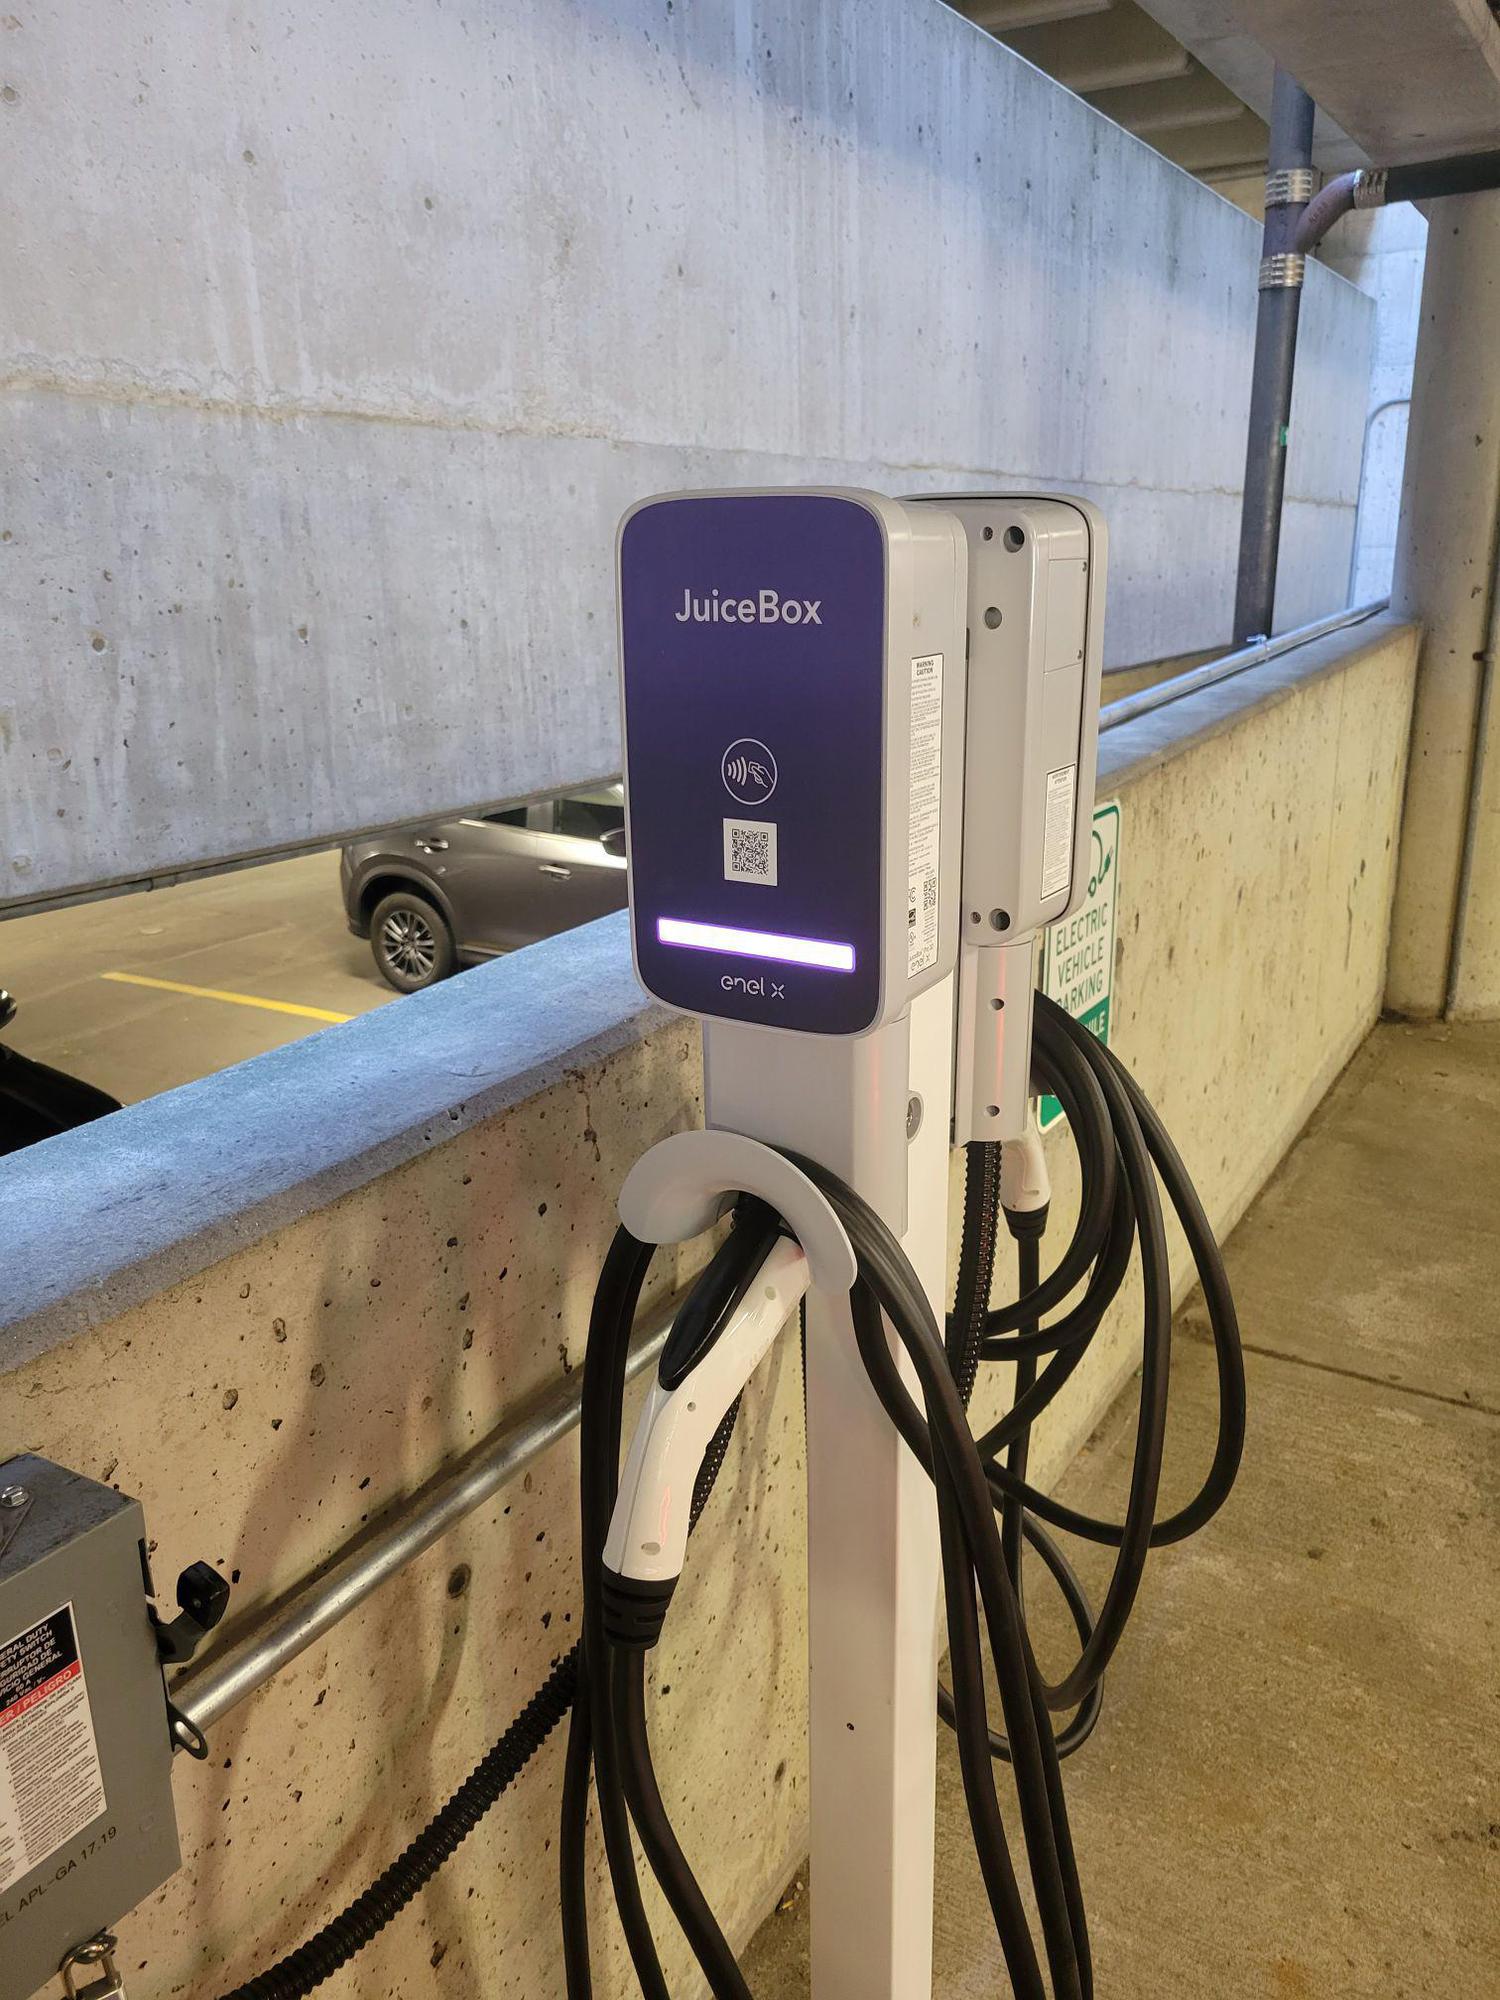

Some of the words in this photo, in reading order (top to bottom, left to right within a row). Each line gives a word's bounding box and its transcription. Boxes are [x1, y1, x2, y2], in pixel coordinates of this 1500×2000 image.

[675, 588, 823, 625] JuiceBox
[1056, 902, 1107, 956] ELECTRIC
[1058, 936, 1104, 988] VEHICLE
[720, 975, 765, 997] enel
[0, 1641, 24, 1660] ERAL
[26, 1623, 48, 1643] DUTY
[0, 1651, 18, 1668] ETY
[20, 1629, 53, 1656] SWITCH
[0, 1646, 42, 1679] RRUPTOR
[44, 1637, 56, 1650] DE
[0, 1659, 39, 1688] GURIDAD
[41, 1648, 52, 1660] DE
[23, 1650, 63, 1680] GENERAL
[23, 1670, 72, 1710] PELIGRO
[19, 1859, 78, 1912] APL-GA
[81, 1826, 117, 1860] 17.19
